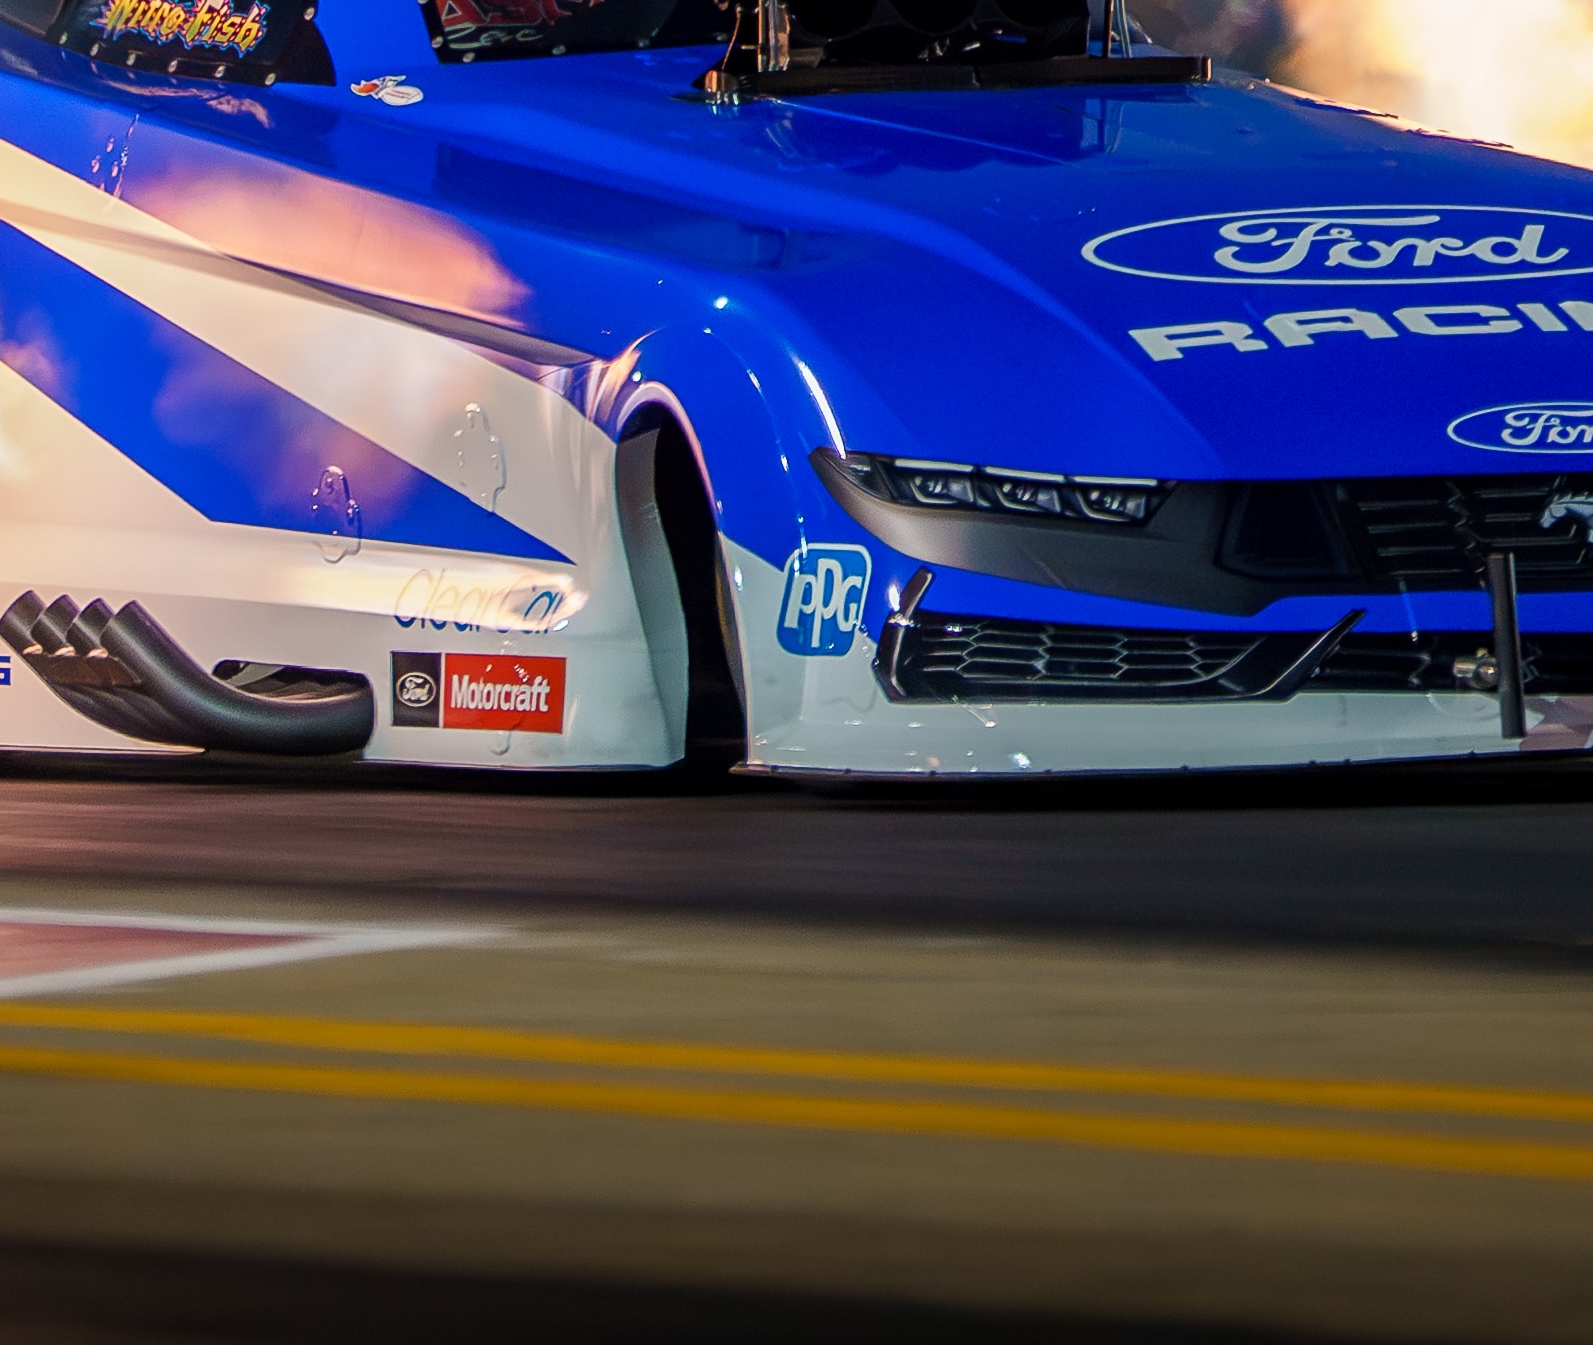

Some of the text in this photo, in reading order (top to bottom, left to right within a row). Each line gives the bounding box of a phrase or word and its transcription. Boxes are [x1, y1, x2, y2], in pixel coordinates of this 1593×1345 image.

[1213, 215, 1570, 273] Ford
[783, 558, 863, 648] PPG
[450, 673, 551, 713] Motorcraft
